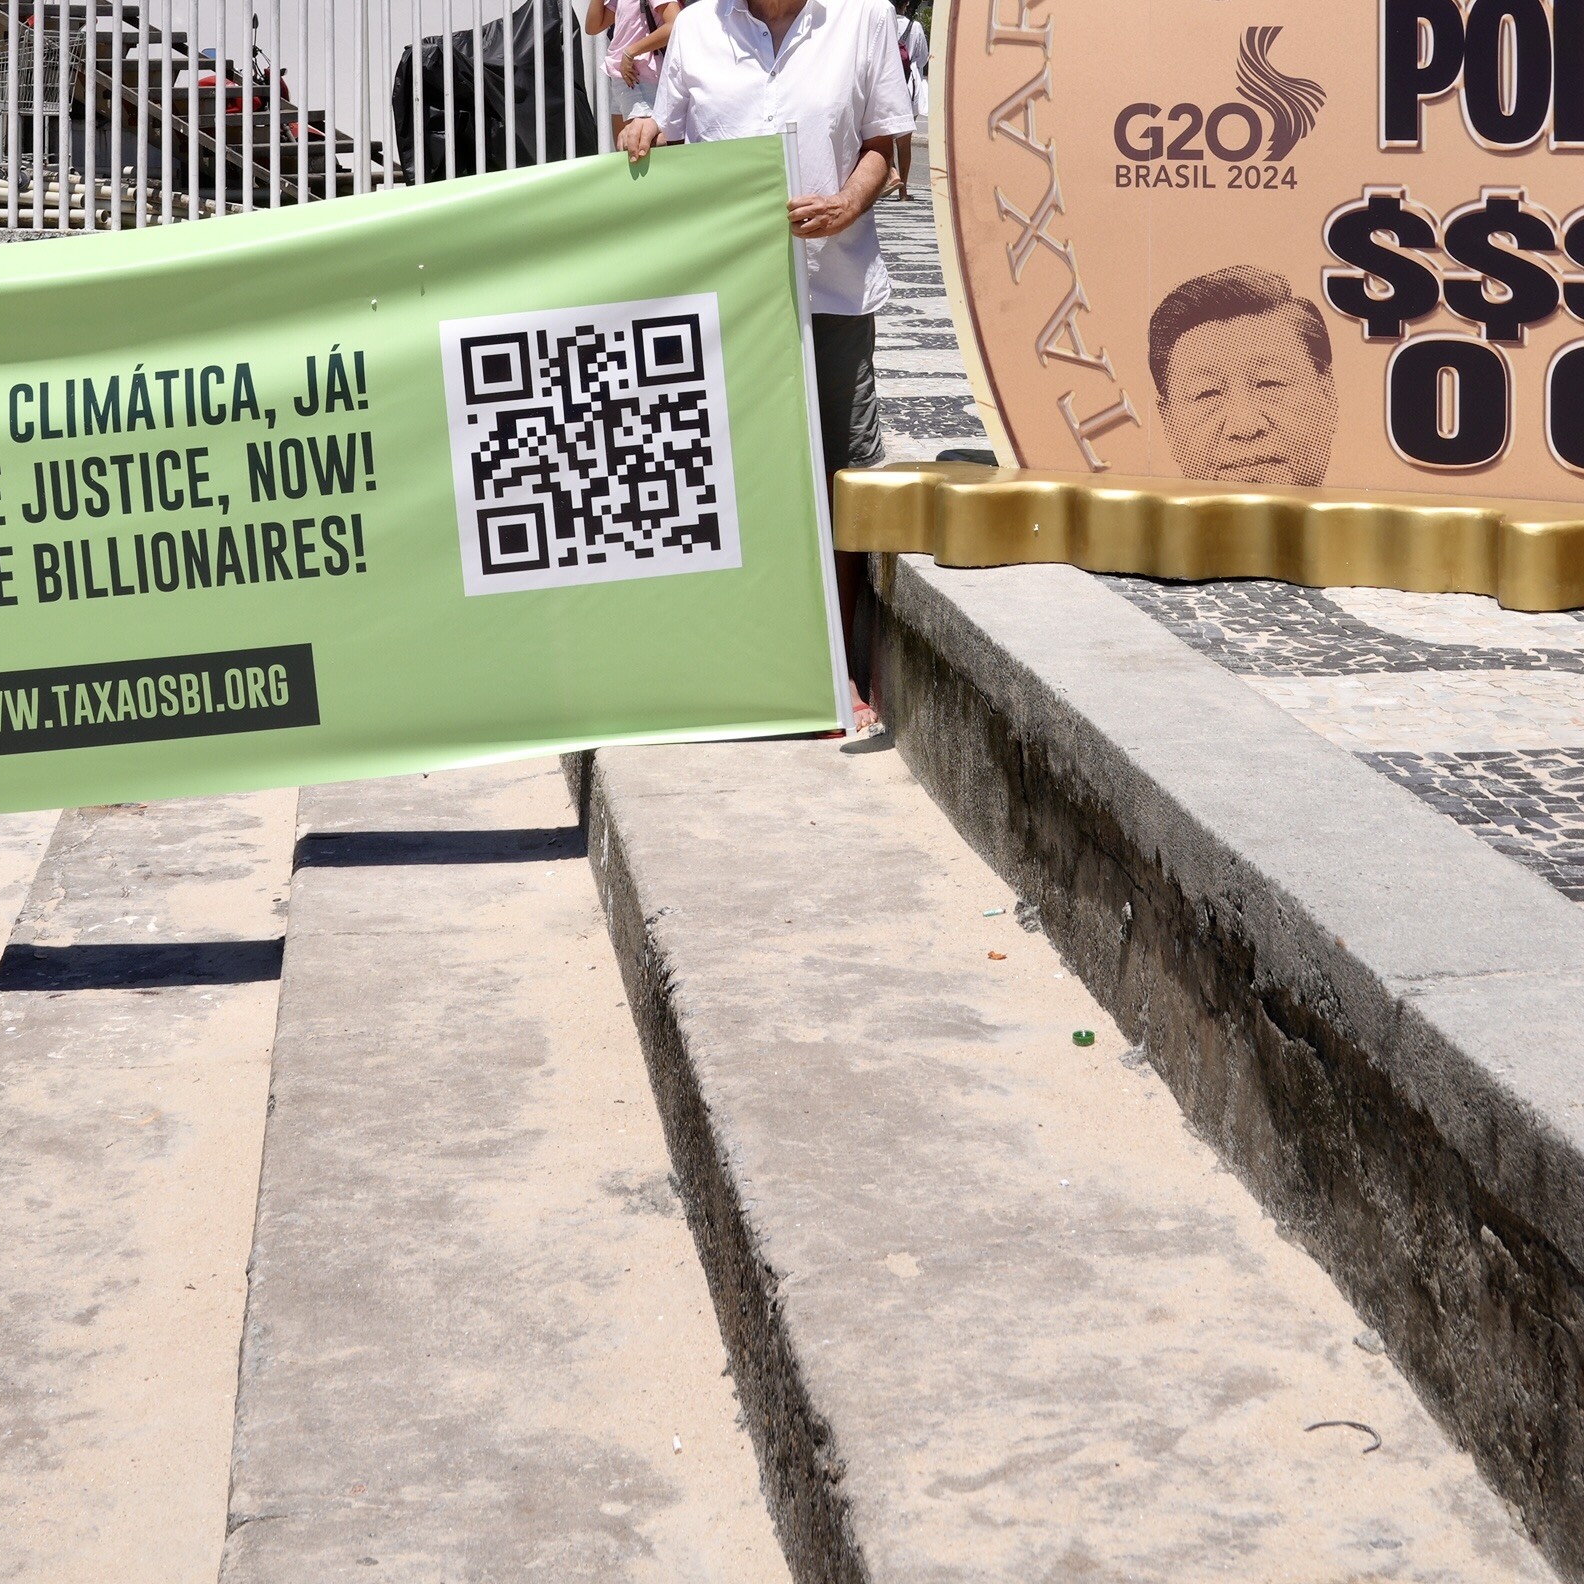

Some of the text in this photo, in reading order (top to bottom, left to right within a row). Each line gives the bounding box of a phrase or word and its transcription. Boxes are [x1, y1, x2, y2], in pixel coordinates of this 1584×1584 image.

[1113, 102, 1263, 162] G20
[1116, 165, 1298, 190] BRASIL 2024
[9, 363, 276, 444] CLIMÁTICA,
[293, 344, 369, 417] JÁ!
[1386, 338, 1514, 471] O
[21, 447, 231, 525] JUSTICE,
[246, 431, 377, 503] NOW!
[33, 513, 368, 604] BILLIONAIRES!
